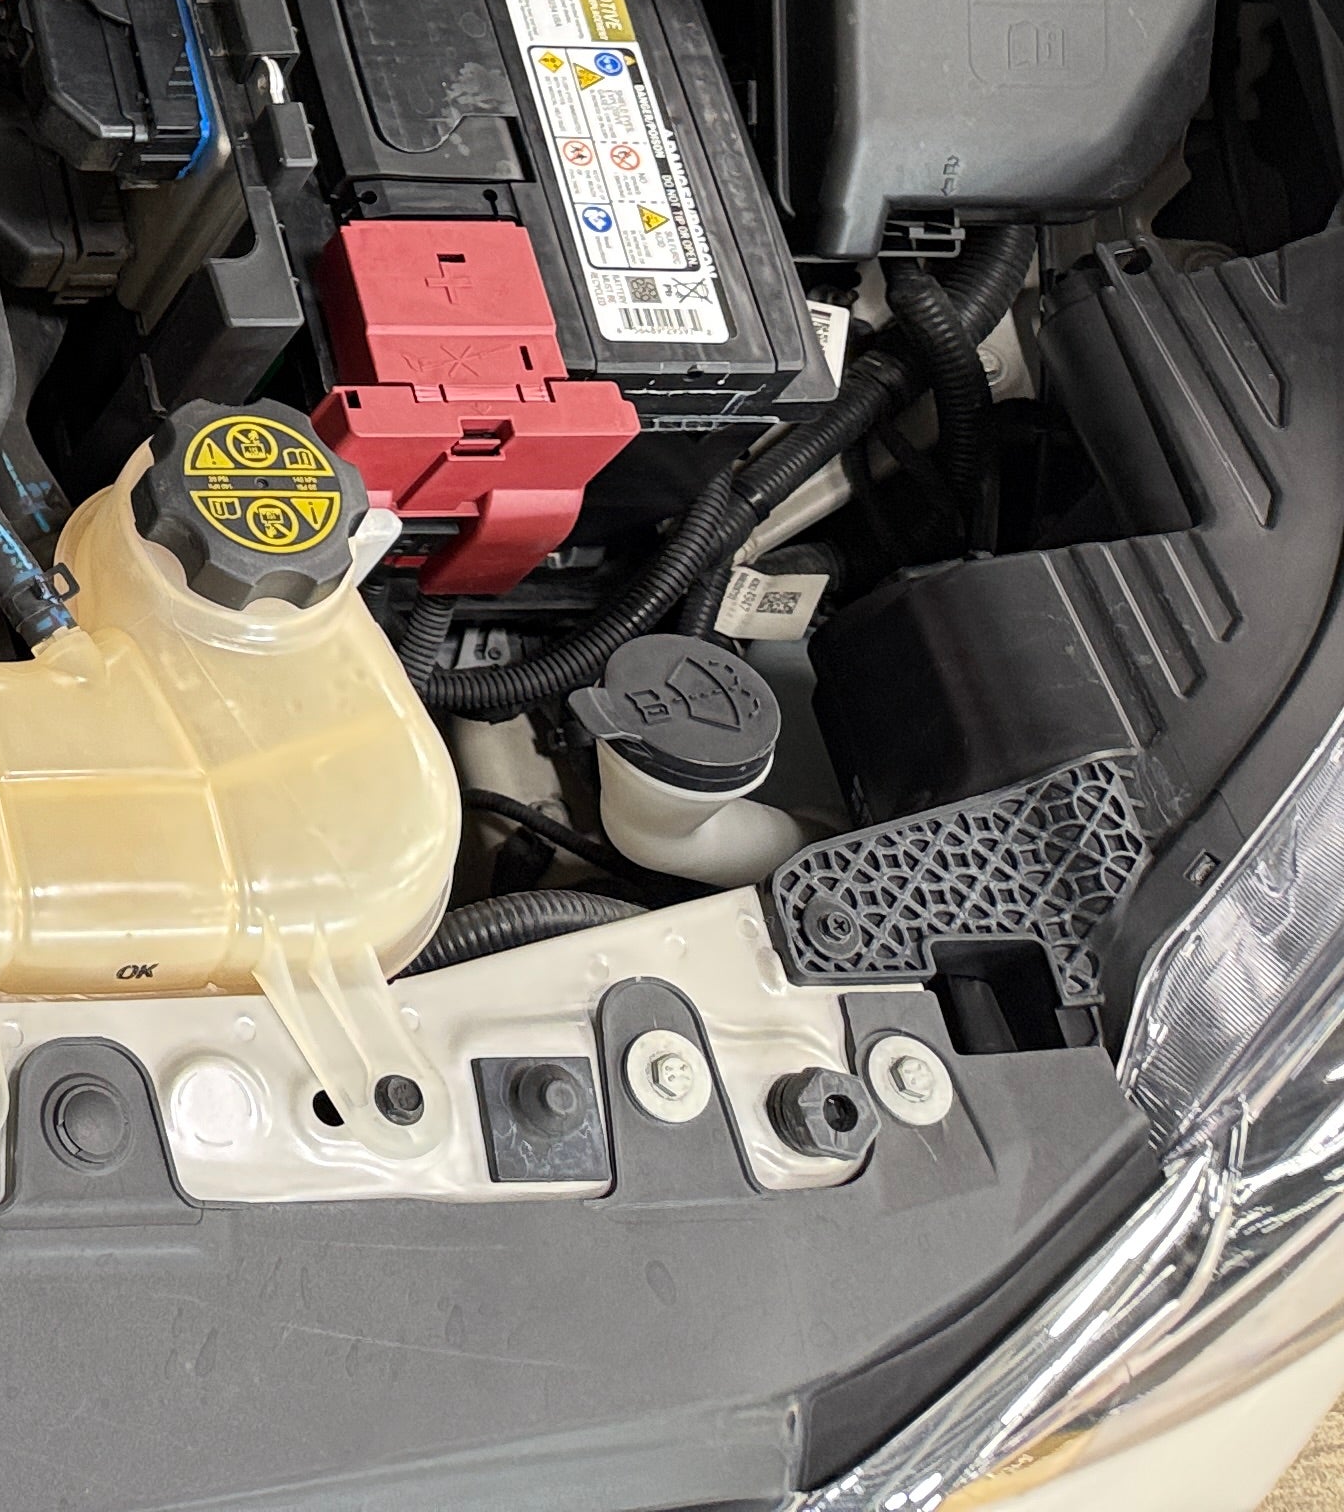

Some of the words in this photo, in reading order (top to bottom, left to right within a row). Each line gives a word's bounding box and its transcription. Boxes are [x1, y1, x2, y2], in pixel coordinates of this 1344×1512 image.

[632, 83, 666, 159] DANGER/POISON
[636, 172, 648, 184] NO
[659, 173, 675, 188] DO
[664, 188, 681, 207] NOT
[670, 209, 686, 225] TIP
[675, 225, 691, 239] OR
[679, 239, 699, 267] OPEN.
[116, 962, 159, 980] OK
